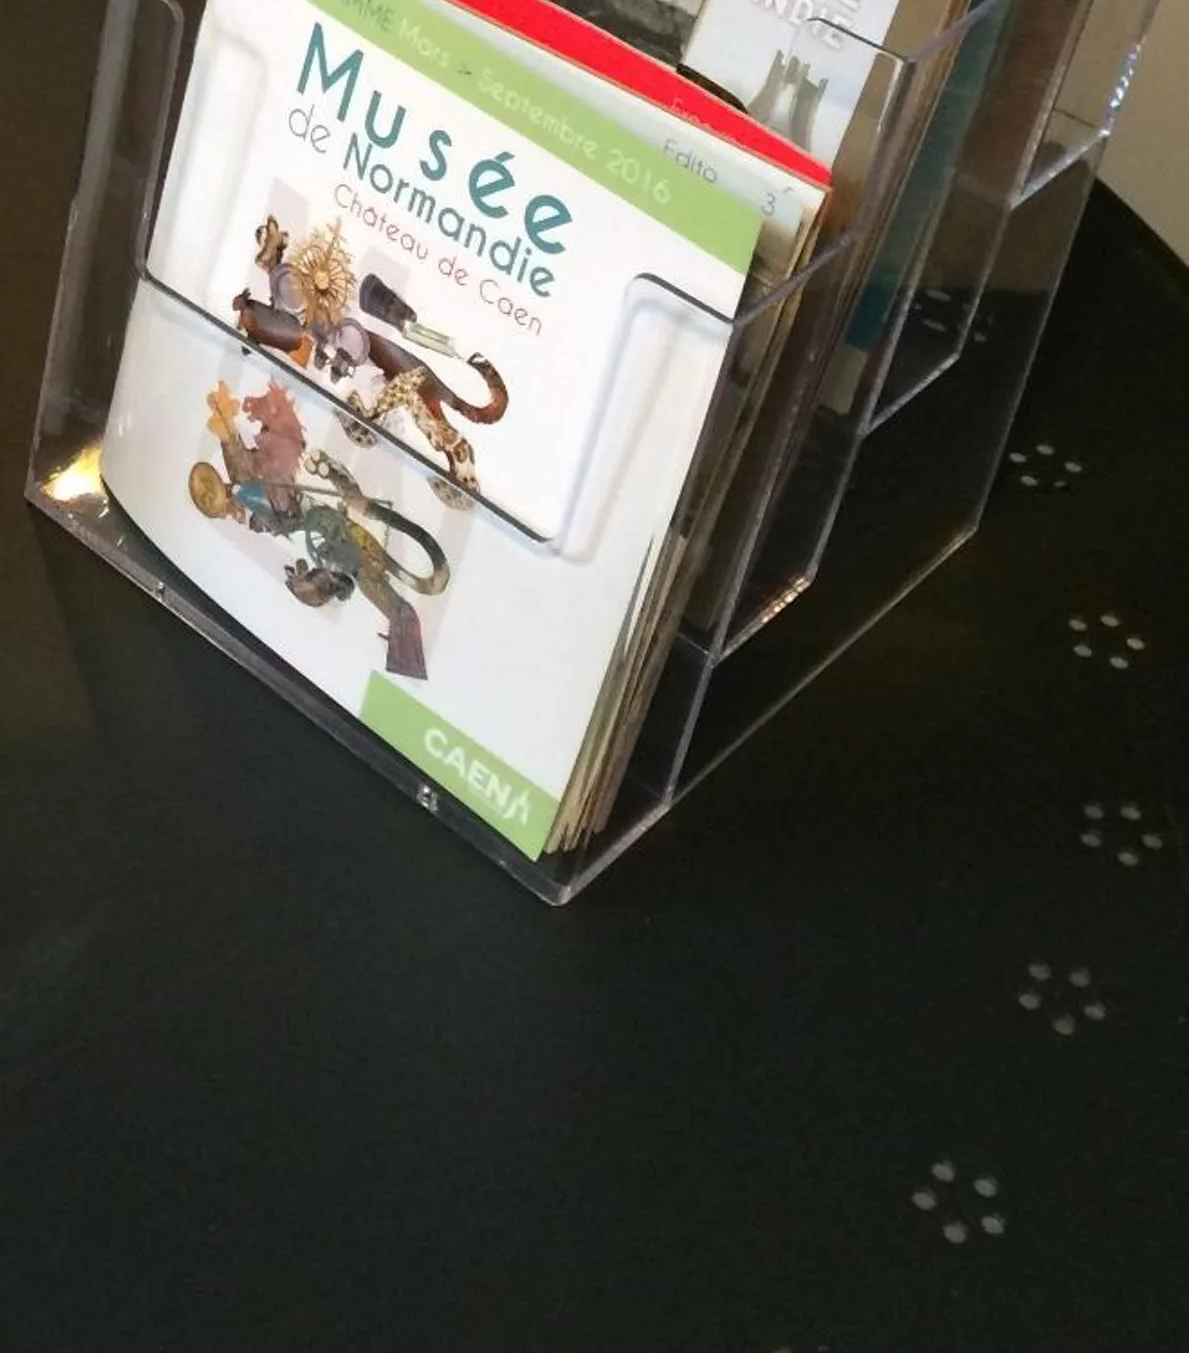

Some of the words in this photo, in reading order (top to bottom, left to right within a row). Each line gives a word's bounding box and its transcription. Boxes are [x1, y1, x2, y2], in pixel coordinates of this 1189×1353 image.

[288, 104, 330, 154] de
[343, 131, 555, 298] Normandie
[296, 21, 573, 256] Musée
[397, 17, 451, 68] Mars
[477, 67, 599, 160] Septembre
[606, 147, 671, 204] 2016
[438, 256, 469, 287] de
[478, 279, 543, 336] Caen
